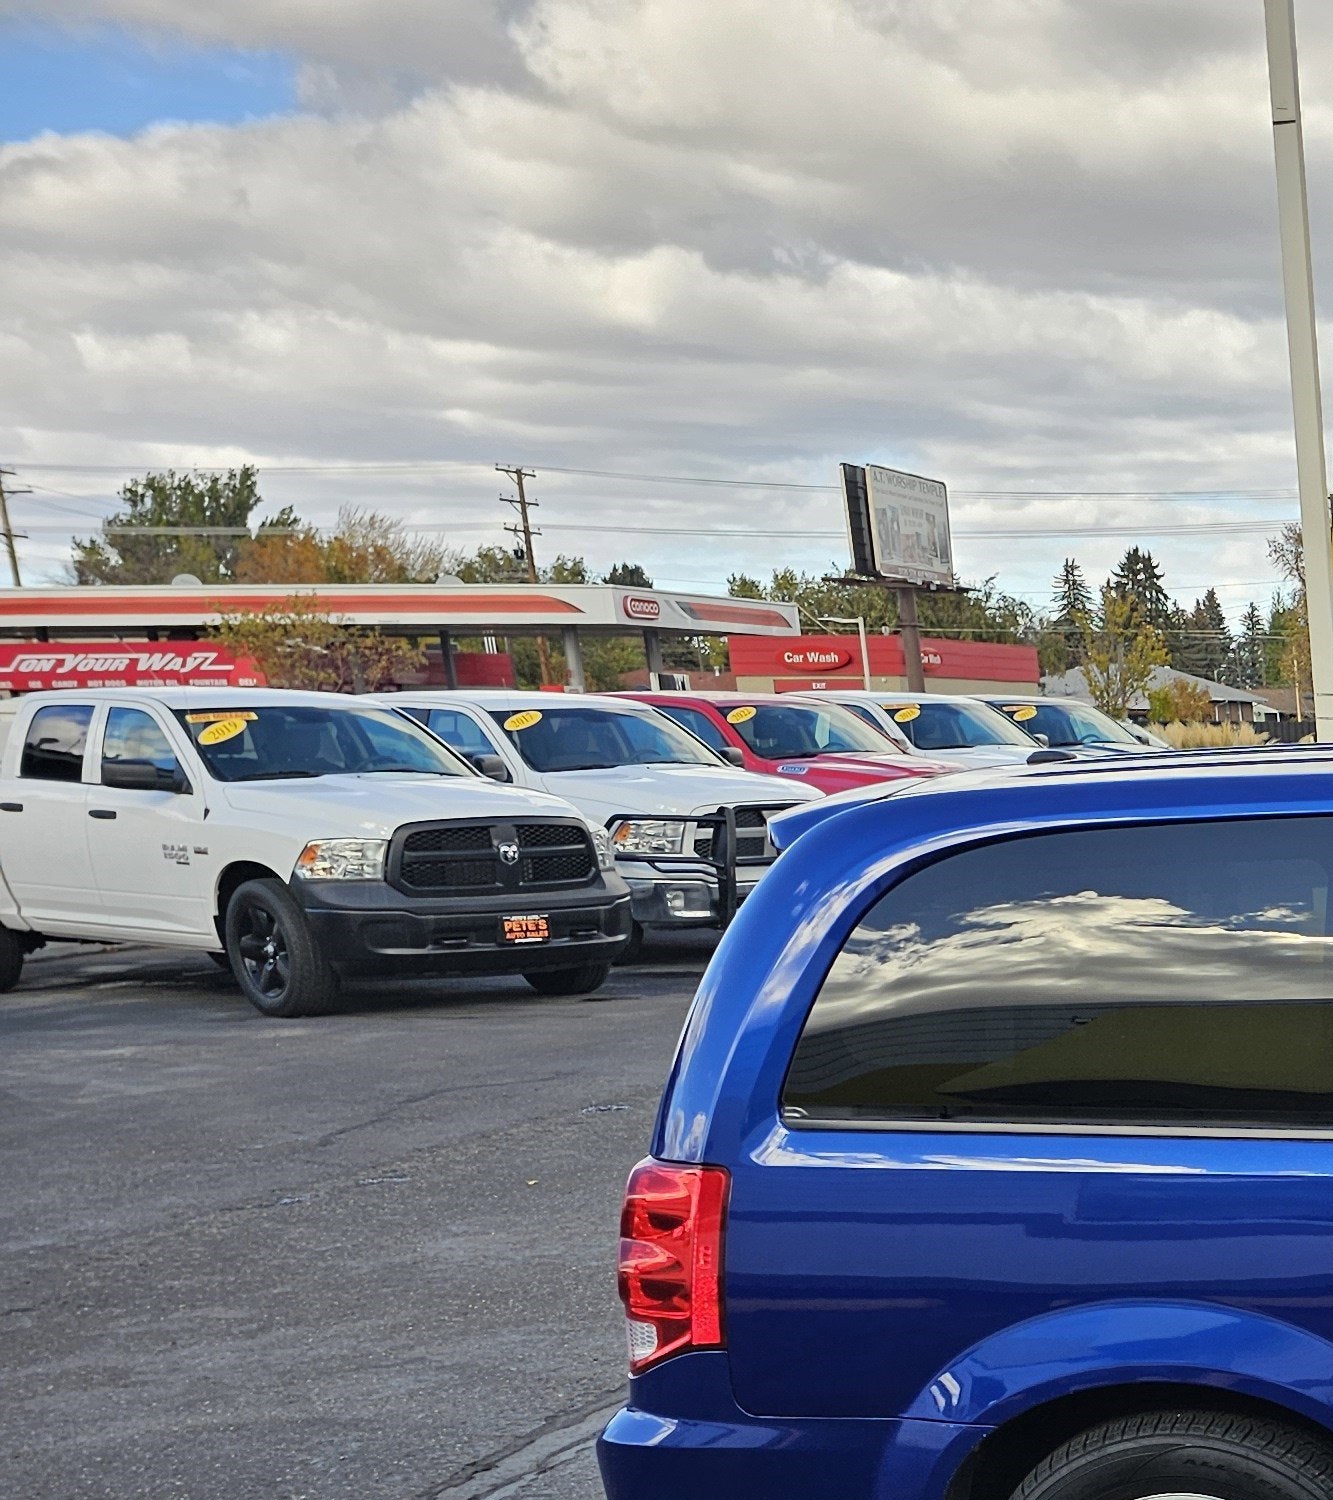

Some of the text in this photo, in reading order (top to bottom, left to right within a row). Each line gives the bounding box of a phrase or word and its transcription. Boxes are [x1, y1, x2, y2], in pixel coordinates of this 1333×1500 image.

[56, 653, 130, 674] YOUR
[784, 652, 839, 664] Car Wash
[210, 720, 239, 741] 2019
[503, 919, 548, 932] PETE'S
